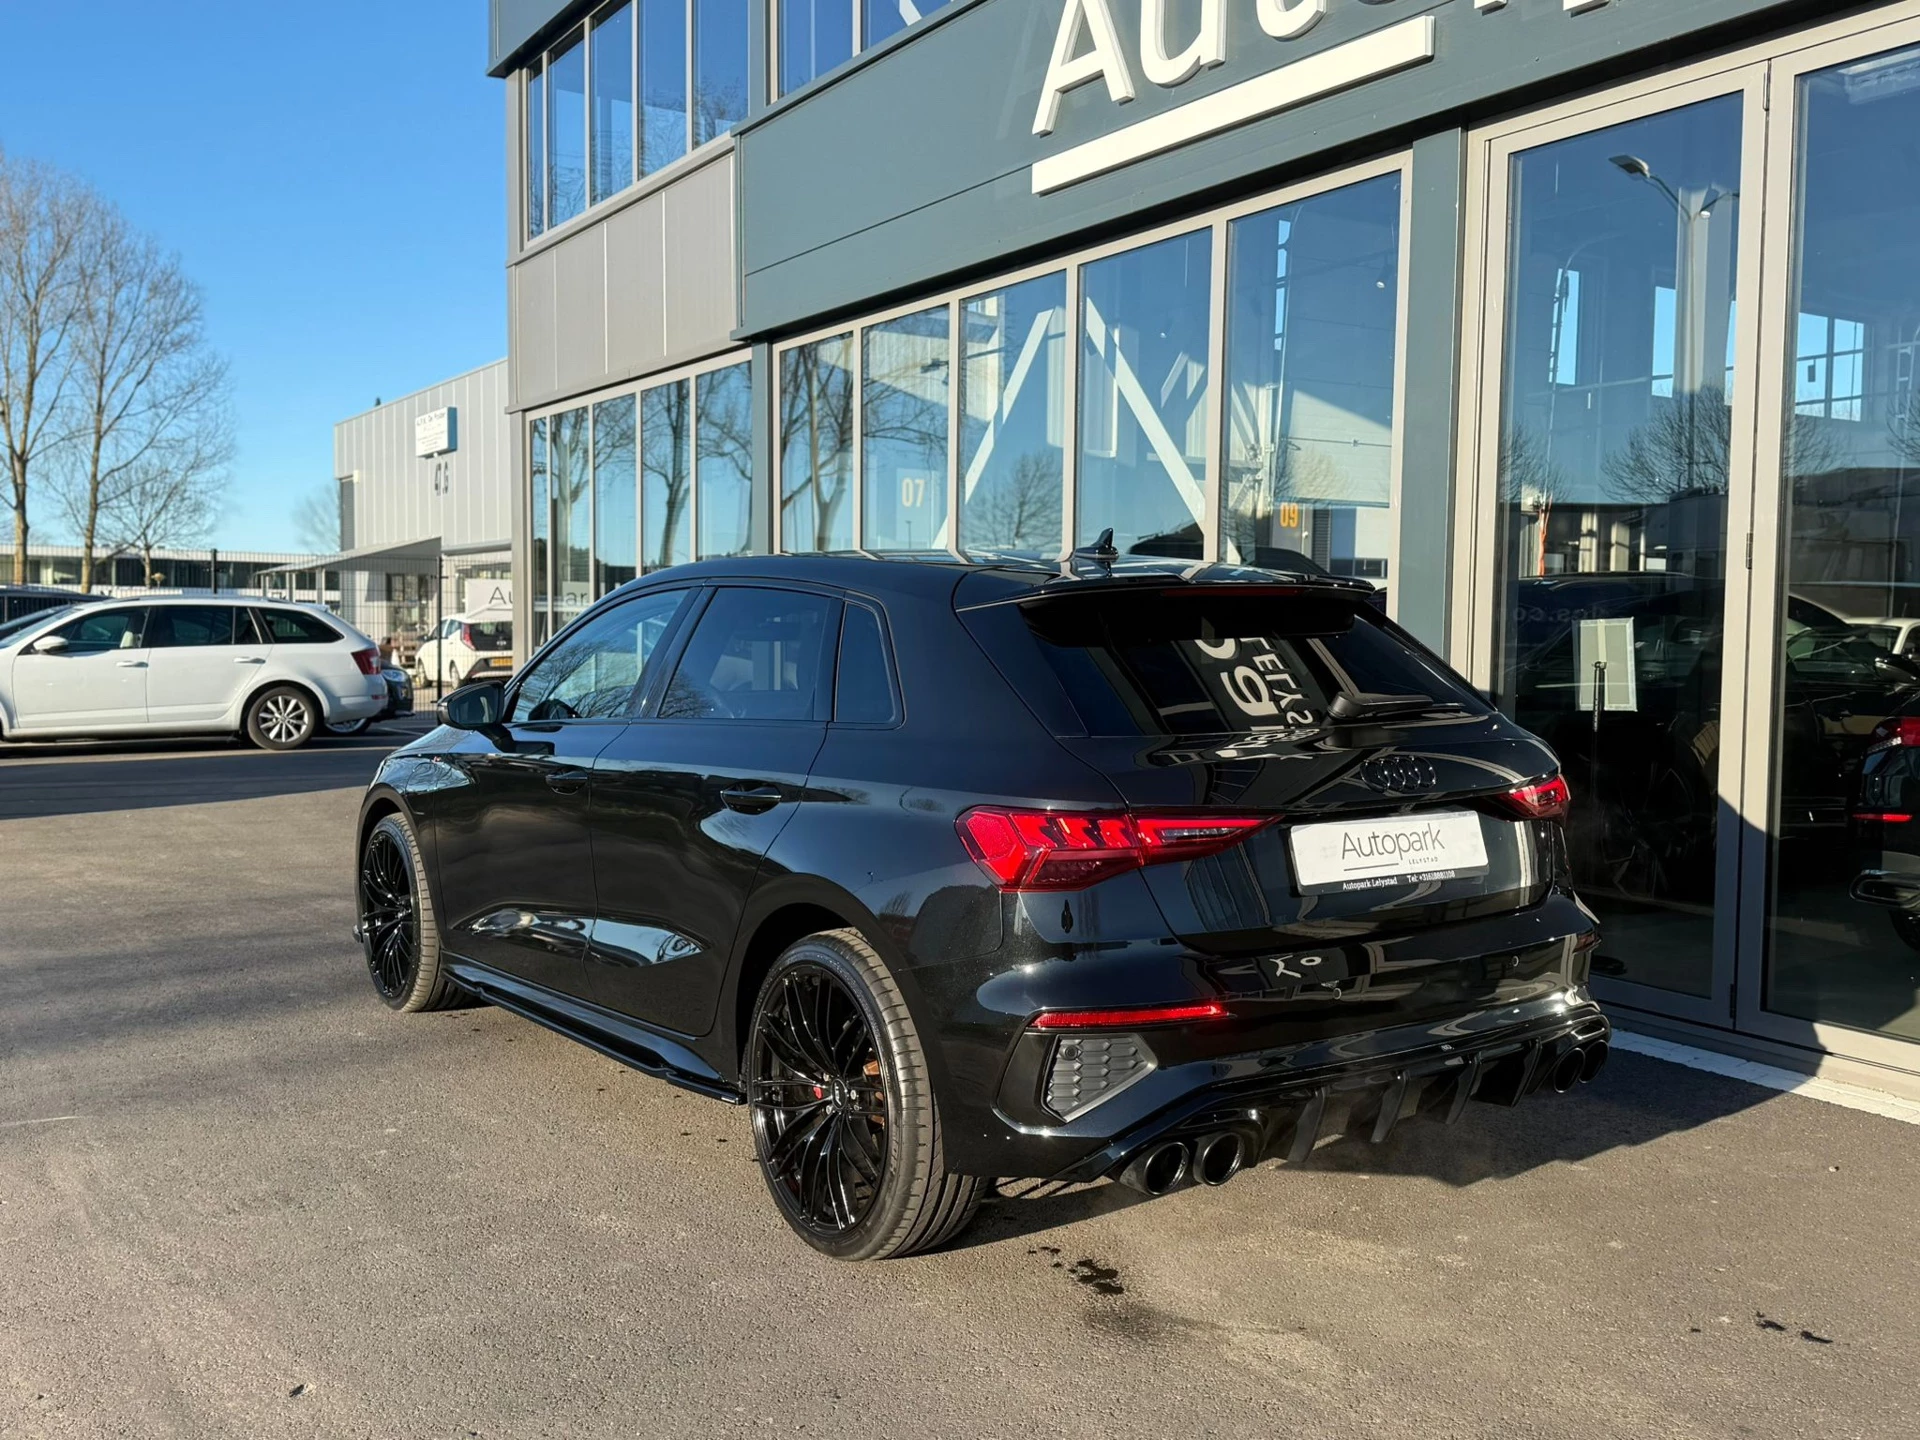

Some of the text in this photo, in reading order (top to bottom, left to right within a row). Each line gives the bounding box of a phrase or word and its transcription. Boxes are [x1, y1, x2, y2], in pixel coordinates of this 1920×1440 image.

[902, 478, 925, 507] 07
[1280, 502, 1299, 528] 09
[1341, 822, 1446, 861] Autopark
[1342, 879, 1371, 891] Autopark
[1371, 876, 1398, 888] Lelystad
